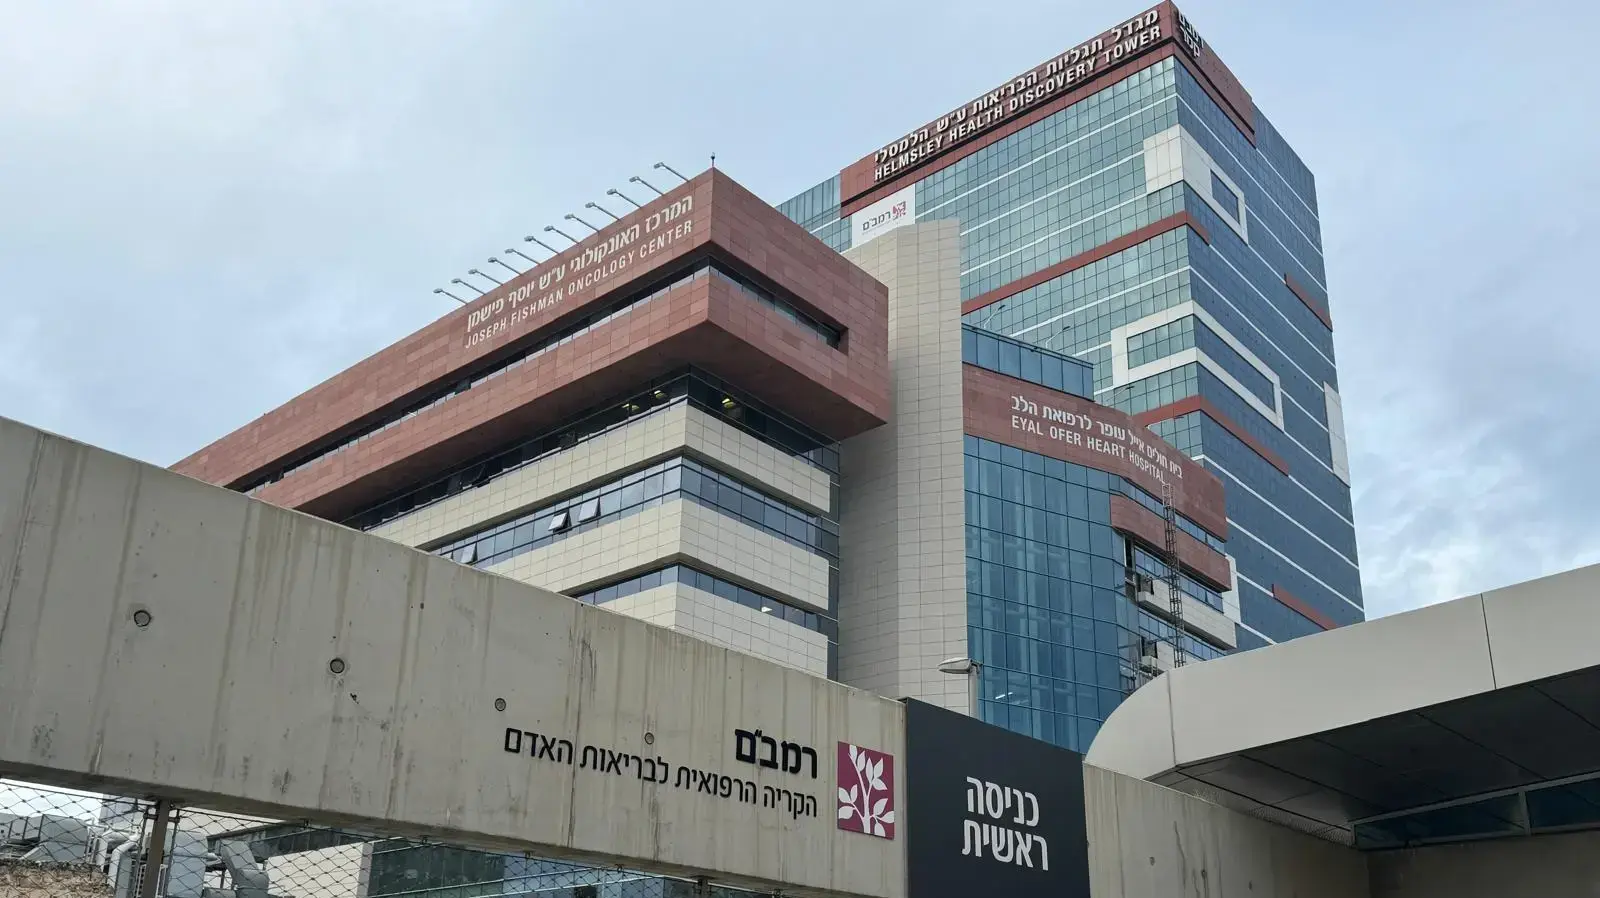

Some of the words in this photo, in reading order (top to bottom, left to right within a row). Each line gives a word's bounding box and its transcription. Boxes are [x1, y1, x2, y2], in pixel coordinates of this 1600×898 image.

[1111, 10, 1159, 43] מגדל
[1046, 38, 1103, 78] תגליות
[874, 135, 943, 180] HELMSLEY
[949, 105, 1005, 142] HEALTH
[1009, 57, 1098, 112] DISCOVERY
[1103, 25, 1161, 64] TOWER
[972, 71, 1038, 115] הבריאות
[874, 128, 929, 163] הלמסלי
[645, 196, 693, 233] המרכז
[570, 225, 640, 271] האונקולוגי
[466, 320, 506, 349] JOSEPH
[511, 287, 563, 326] FISHMAN
[568, 250, 635, 295] ONCOLOGY
[640, 219, 693, 258] CENTER
[508, 280, 534, 308] יוסף
[467, 298, 504, 332] פישמן
[1011, 395, 1038, 416] הלב
[1042, 406, 1093, 431] לרפואת
[1011, 415, 1044, 436] EYAL
[1049, 426, 1082, 447] OFER
[1087, 436, 1126, 459] HEART
[1129, 449, 1165, 485] HOSPITAL
[1096, 421, 1126, 441] עופר
[1146, 444, 1168, 469] חולים
[1170, 460, 1183, 479] בית
[503, 727, 574, 766] האדם
[579, 744, 669, 785] לבריאות
[675, 765, 757, 805] הרפואית
[763, 785, 817, 820] הקריה
[966, 776, 1040, 827] כניסה
[961, 819, 1049, 871] ראשית
